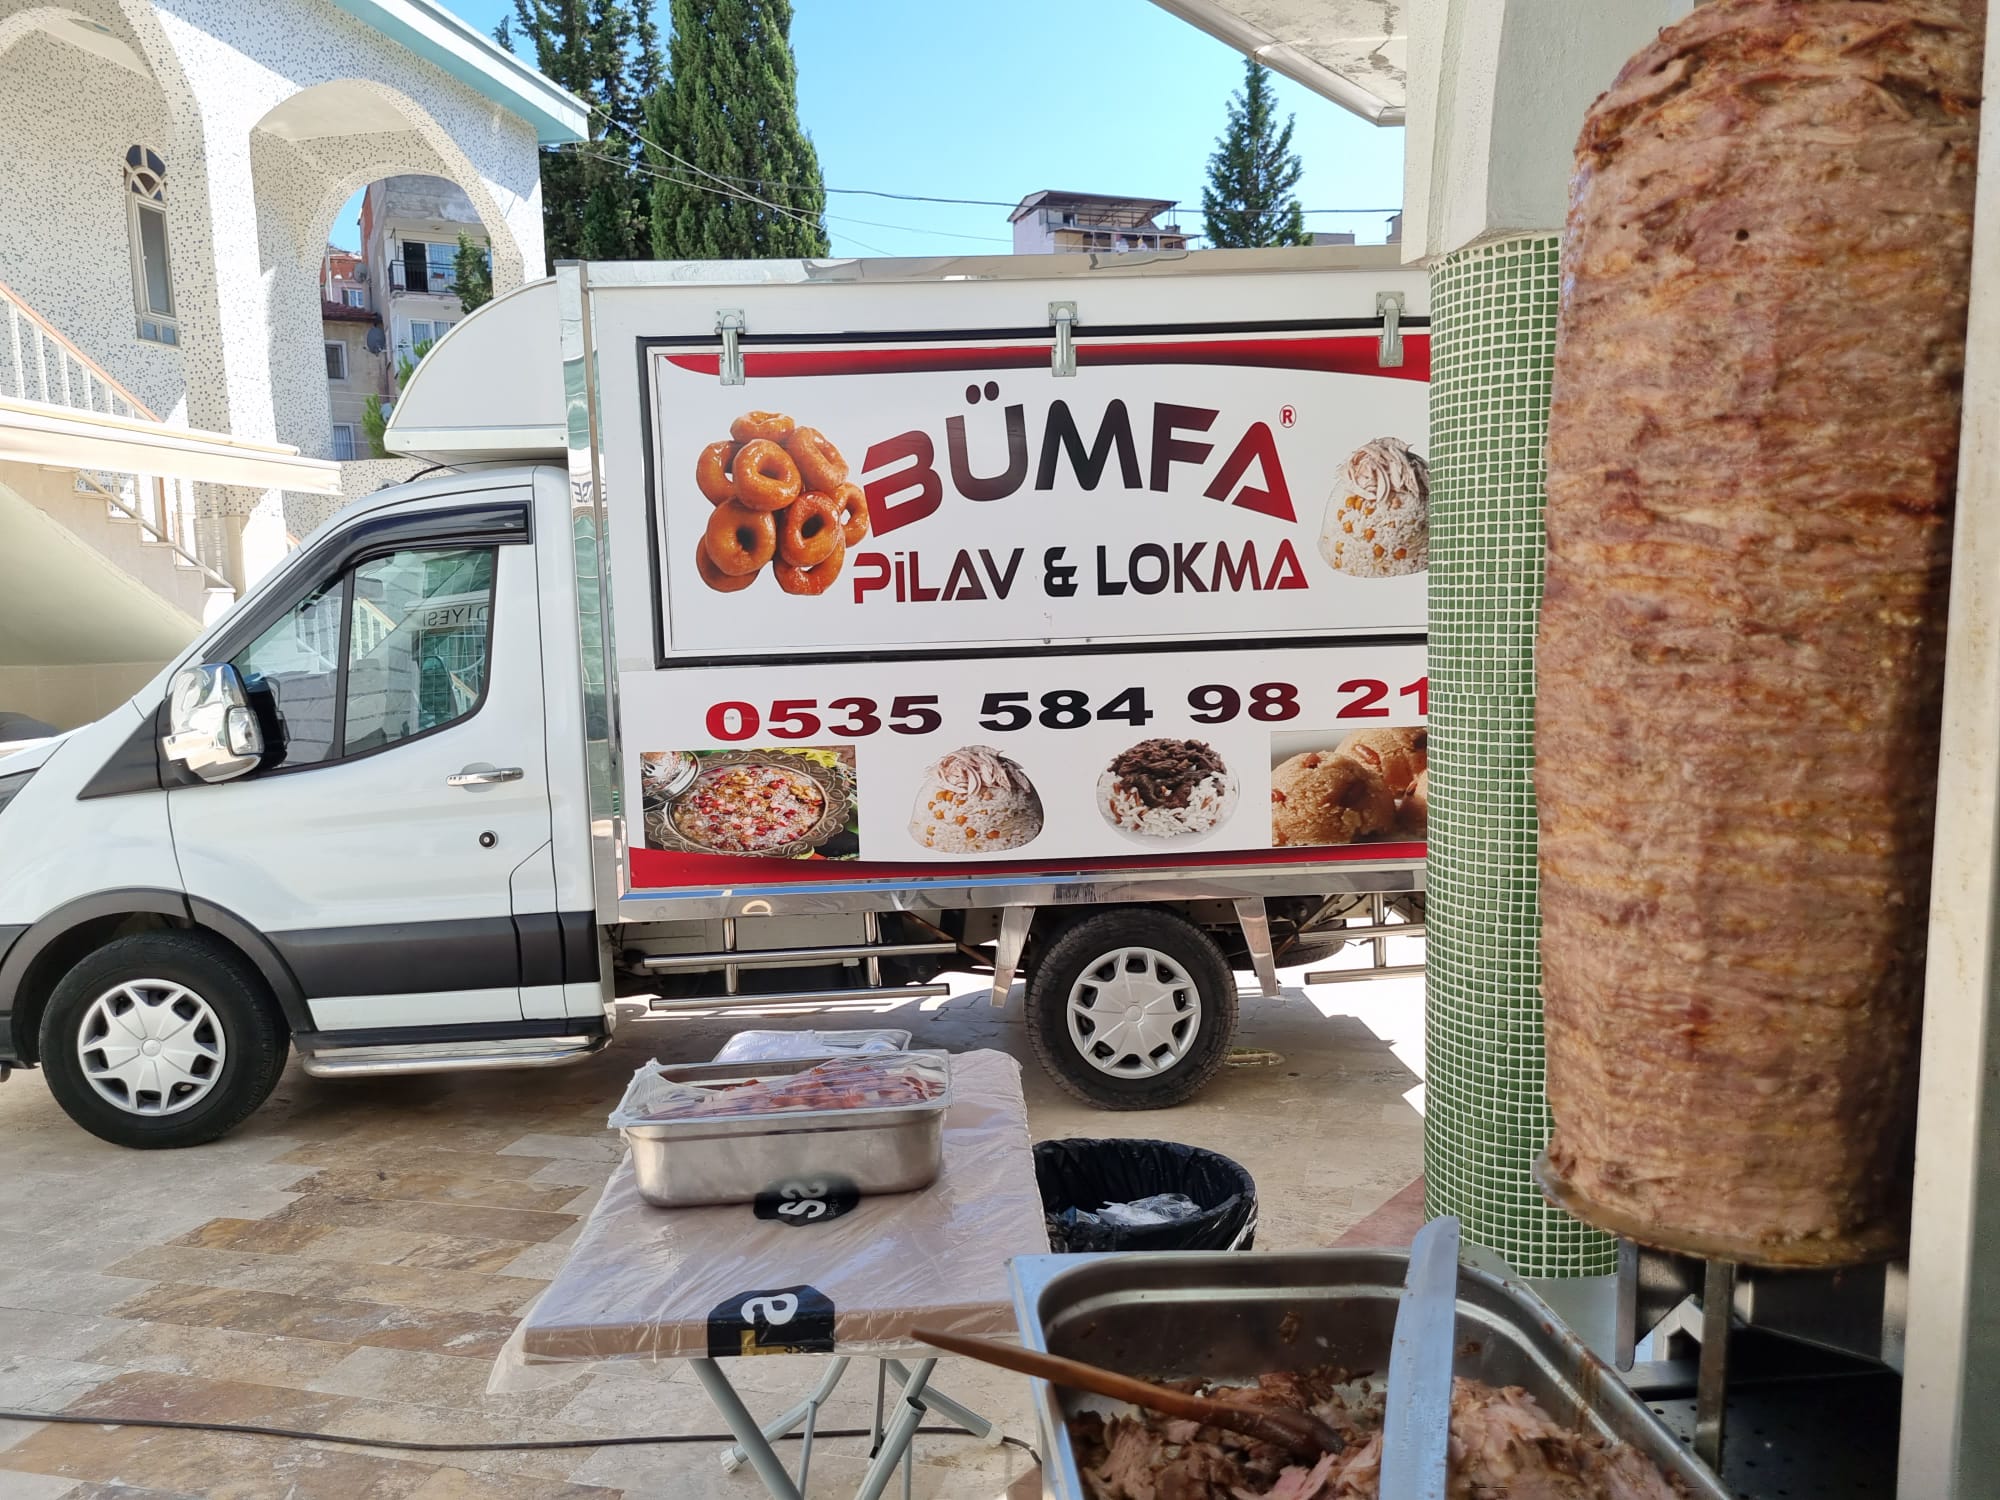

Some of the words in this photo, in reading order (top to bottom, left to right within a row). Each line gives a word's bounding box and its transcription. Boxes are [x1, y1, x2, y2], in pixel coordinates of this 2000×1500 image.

[861, 381, 1297, 537] BÜMFA
[1043, 546, 1078, 597] &
[1096, 538, 1310, 596] LOKMA
[705, 696, 942, 741] 0535
[978, 687, 1154, 731] 584
[1187, 682, 1301, 724] 98
[1335, 677, 1428, 719] 21
